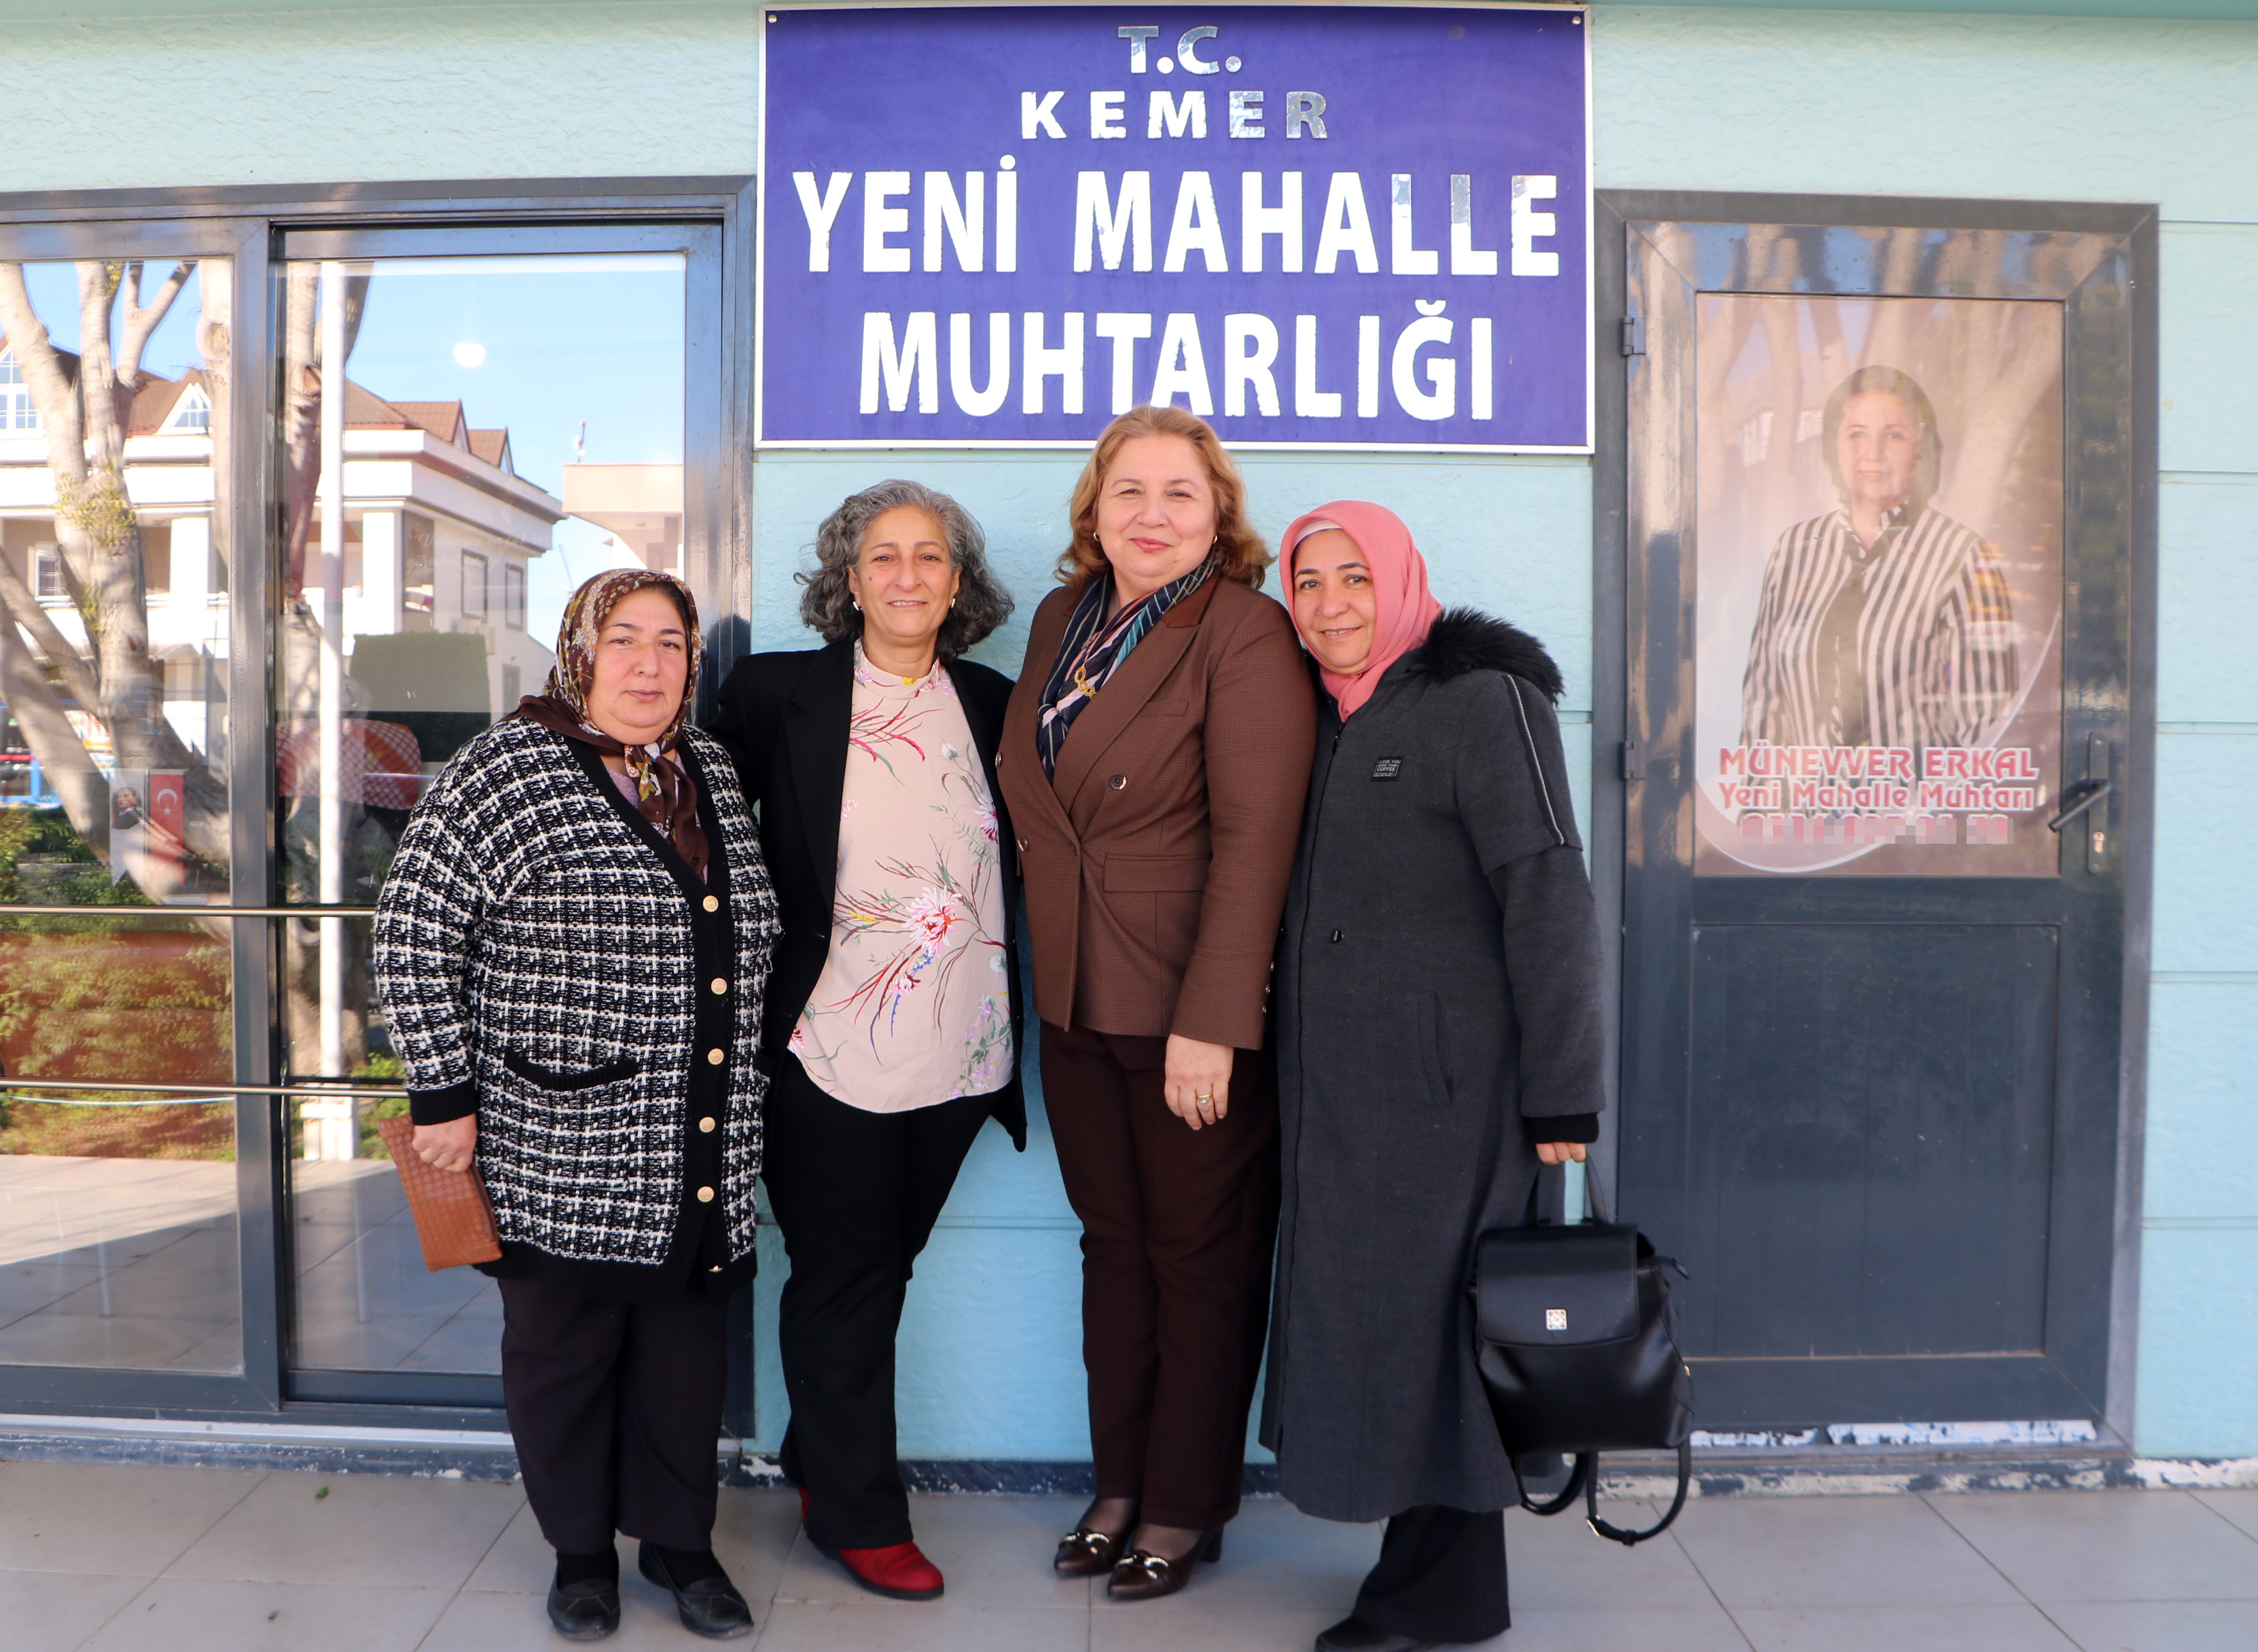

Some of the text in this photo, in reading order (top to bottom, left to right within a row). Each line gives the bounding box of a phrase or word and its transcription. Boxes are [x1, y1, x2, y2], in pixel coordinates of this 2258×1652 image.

[1117, 24, 1243, 75] T.C.
[1020, 90, 1329, 141] KEMER
[792, 154, 1560, 277] YENİ MAHALLE
[859, 298, 1494, 421] MUHTARLIĞI
[1719, 740, 2038, 780] MÜNEVVER ERKAL
[1719, 781, 2032, 810] Yeni Mahalle Muhtarı
